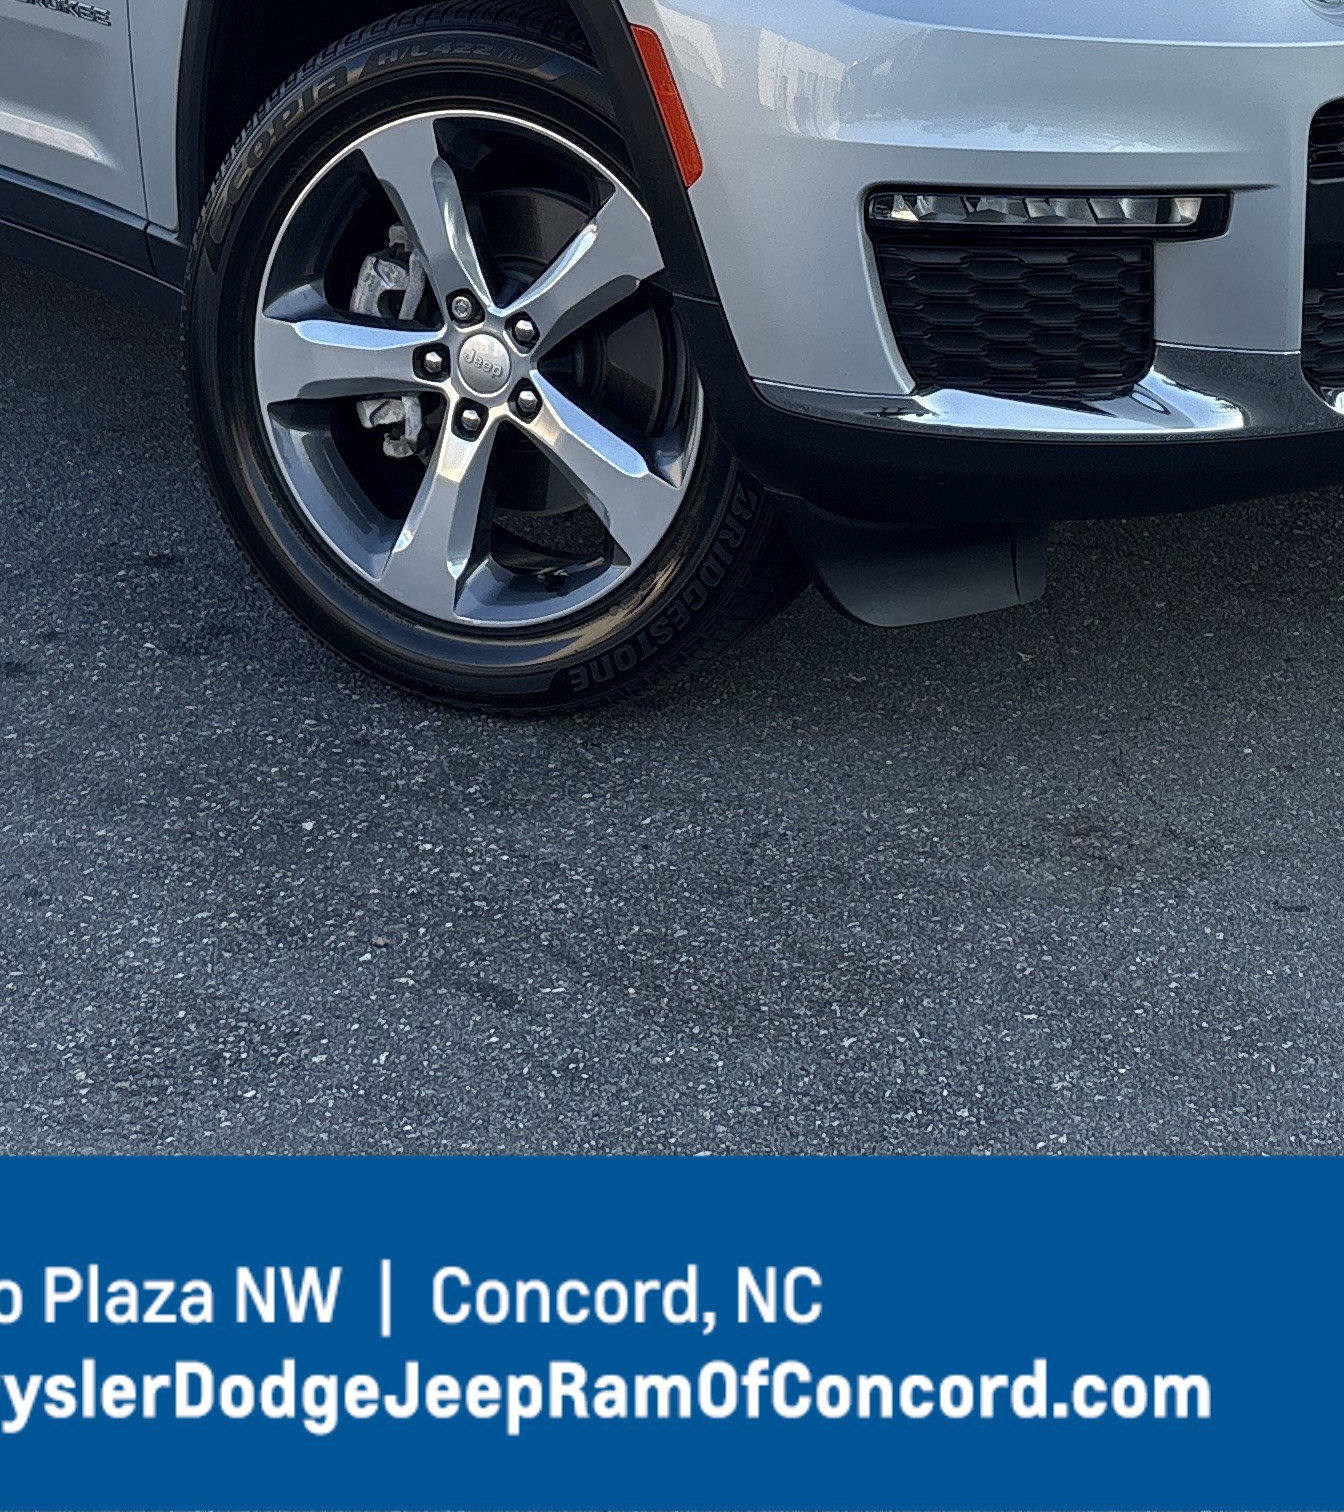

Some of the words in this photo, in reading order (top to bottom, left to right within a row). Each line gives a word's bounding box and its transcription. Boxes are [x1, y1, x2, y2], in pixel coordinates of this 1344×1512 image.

[377, 43, 429, 66] H/L
[433, 41, 494, 55] 422
[462, 347, 504, 379] Jeep
[568, 482, 759, 693] BRIDGESTONE
